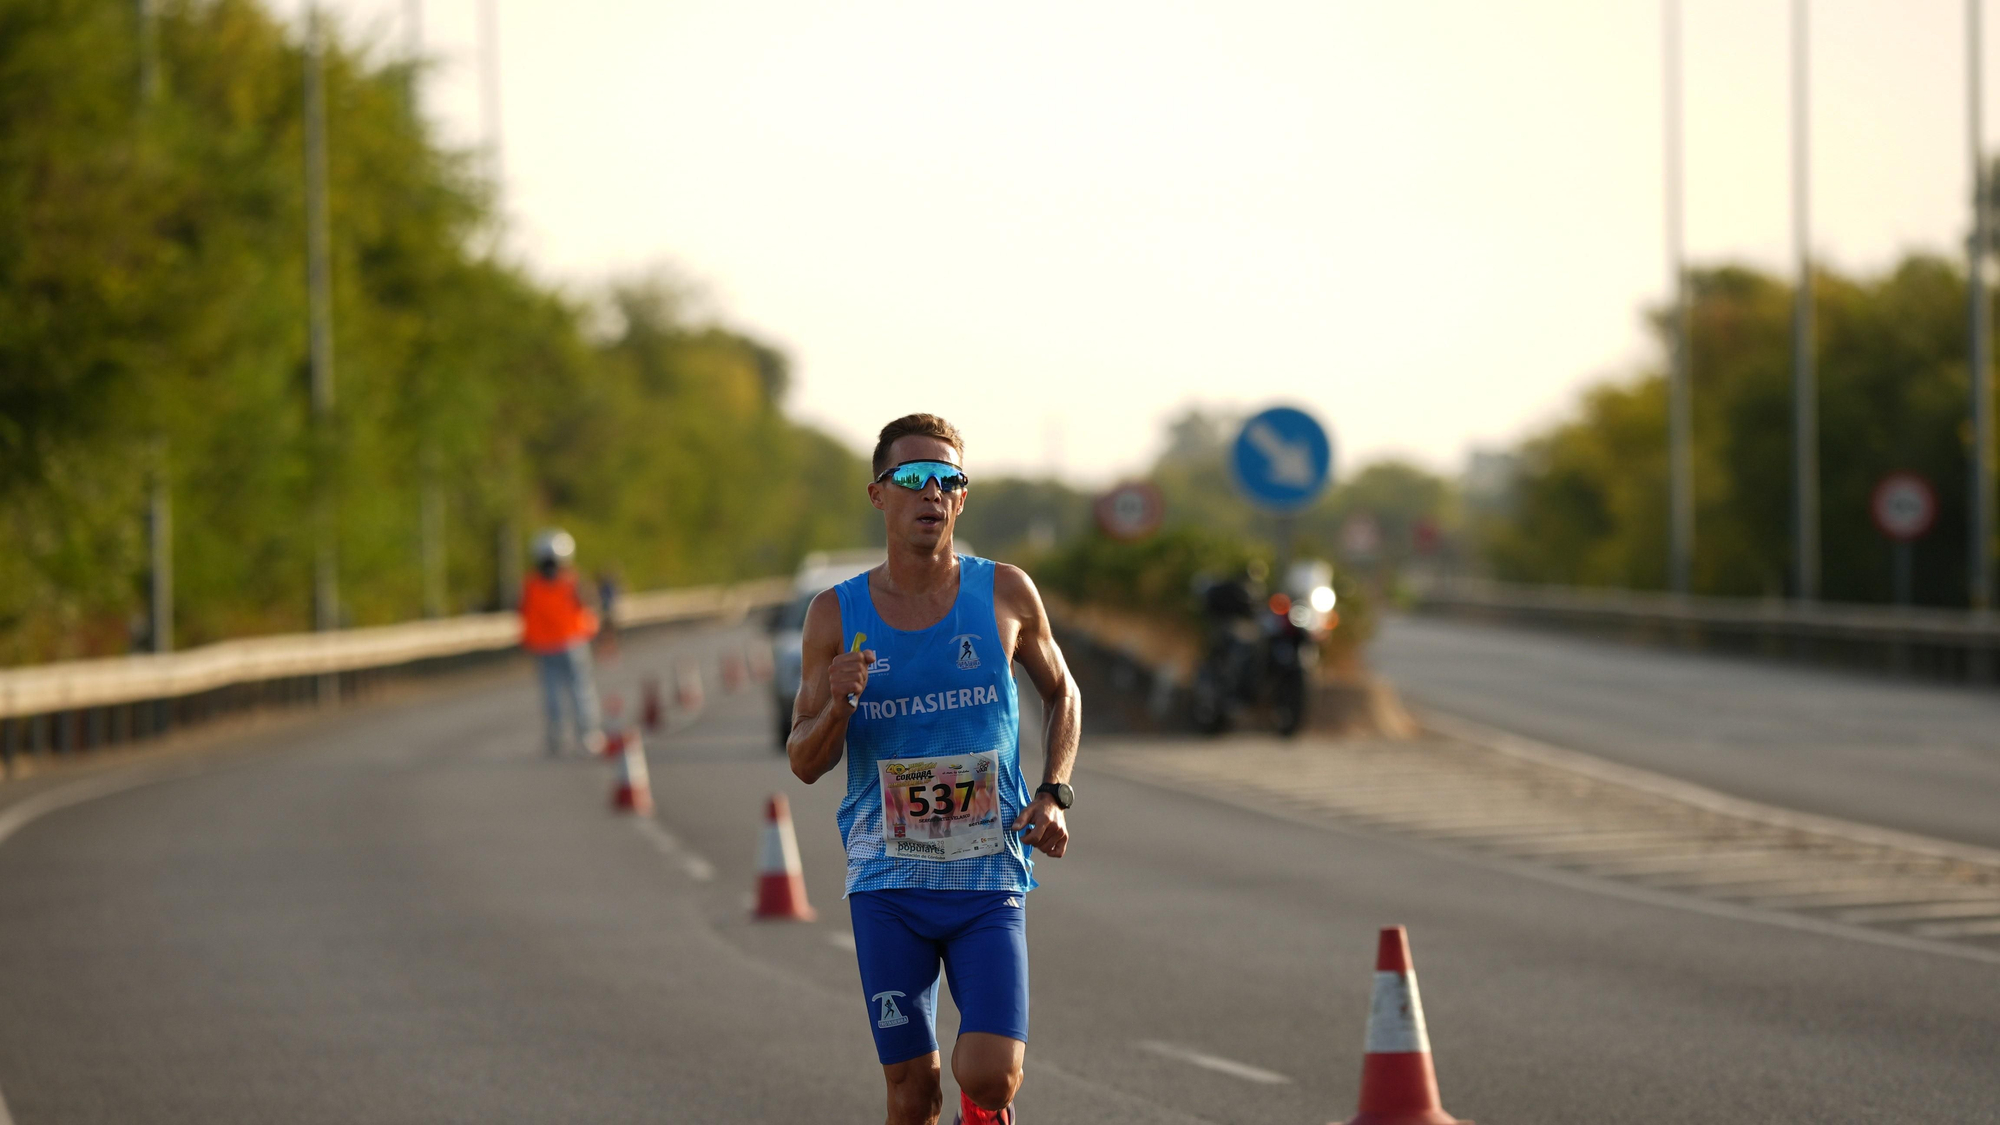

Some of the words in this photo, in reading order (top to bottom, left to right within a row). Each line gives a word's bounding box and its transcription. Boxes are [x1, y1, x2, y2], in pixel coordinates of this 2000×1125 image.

[860, 684, 999, 720] TROTASIERRA
[909, 780, 975, 817] 537
[897, 843, 946, 855] populares
